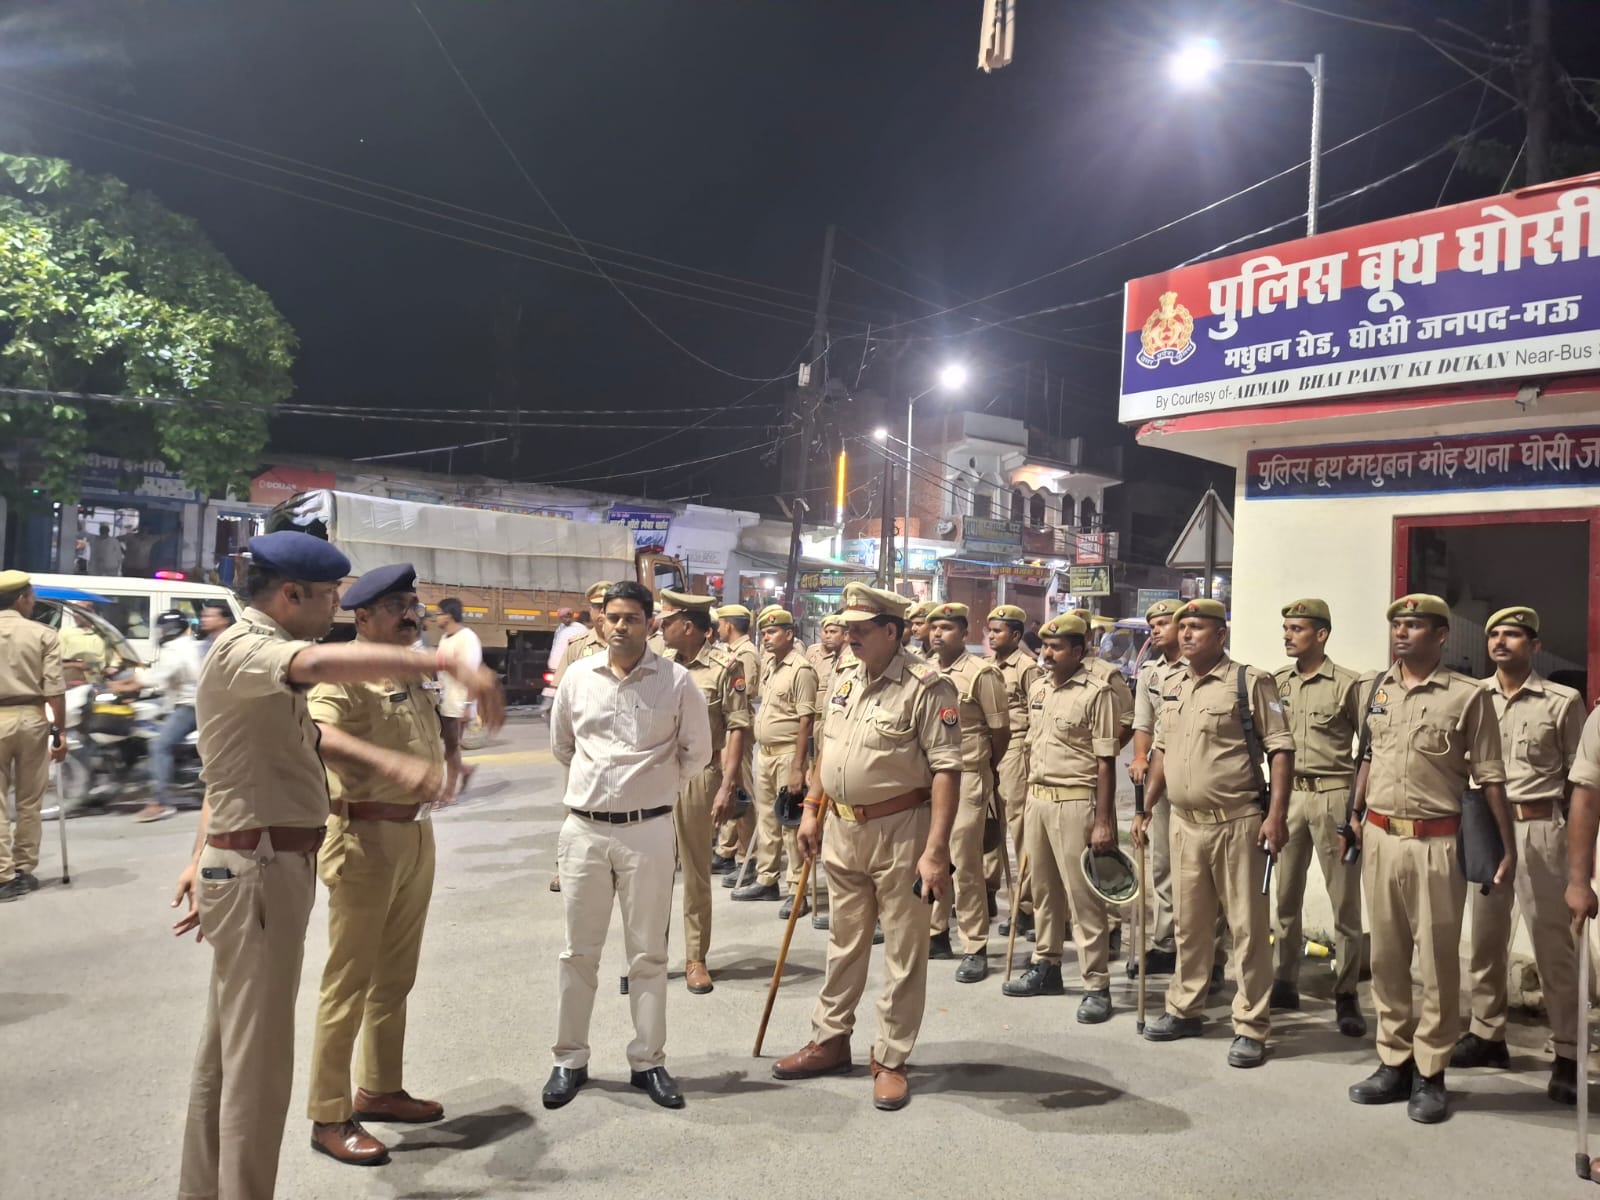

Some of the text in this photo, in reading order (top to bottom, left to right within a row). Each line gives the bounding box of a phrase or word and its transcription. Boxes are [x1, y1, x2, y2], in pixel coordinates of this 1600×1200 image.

[1208, 186, 1600, 340] पुलिस बूथ घोसी
[1224, 295, 1583, 375] मधुबन रोड, घोसी जनपद-मऊ
[1156, 395, 1169, 410] By
[1171, 388, 1216, 407] Courtesy
[1233, 378, 1290, 399] AHMAD
[1299, 369, 1342, 391] BHAI
[1347, 363, 1403, 385] PAINT
[1408, 360, 1433, 378] KI
[1437, 351, 1509, 374] DUKAN
[1257, 454, 1312, 490] पुलिस
[1314, 456, 1347, 488] बूथ
[1347, 451, 1417, 487] मधुबन
[1418, 442, 1464, 478] मोड़
[1463, 444, 1514, 474] थाना
[1519, 432, 1576, 471] घोसी
